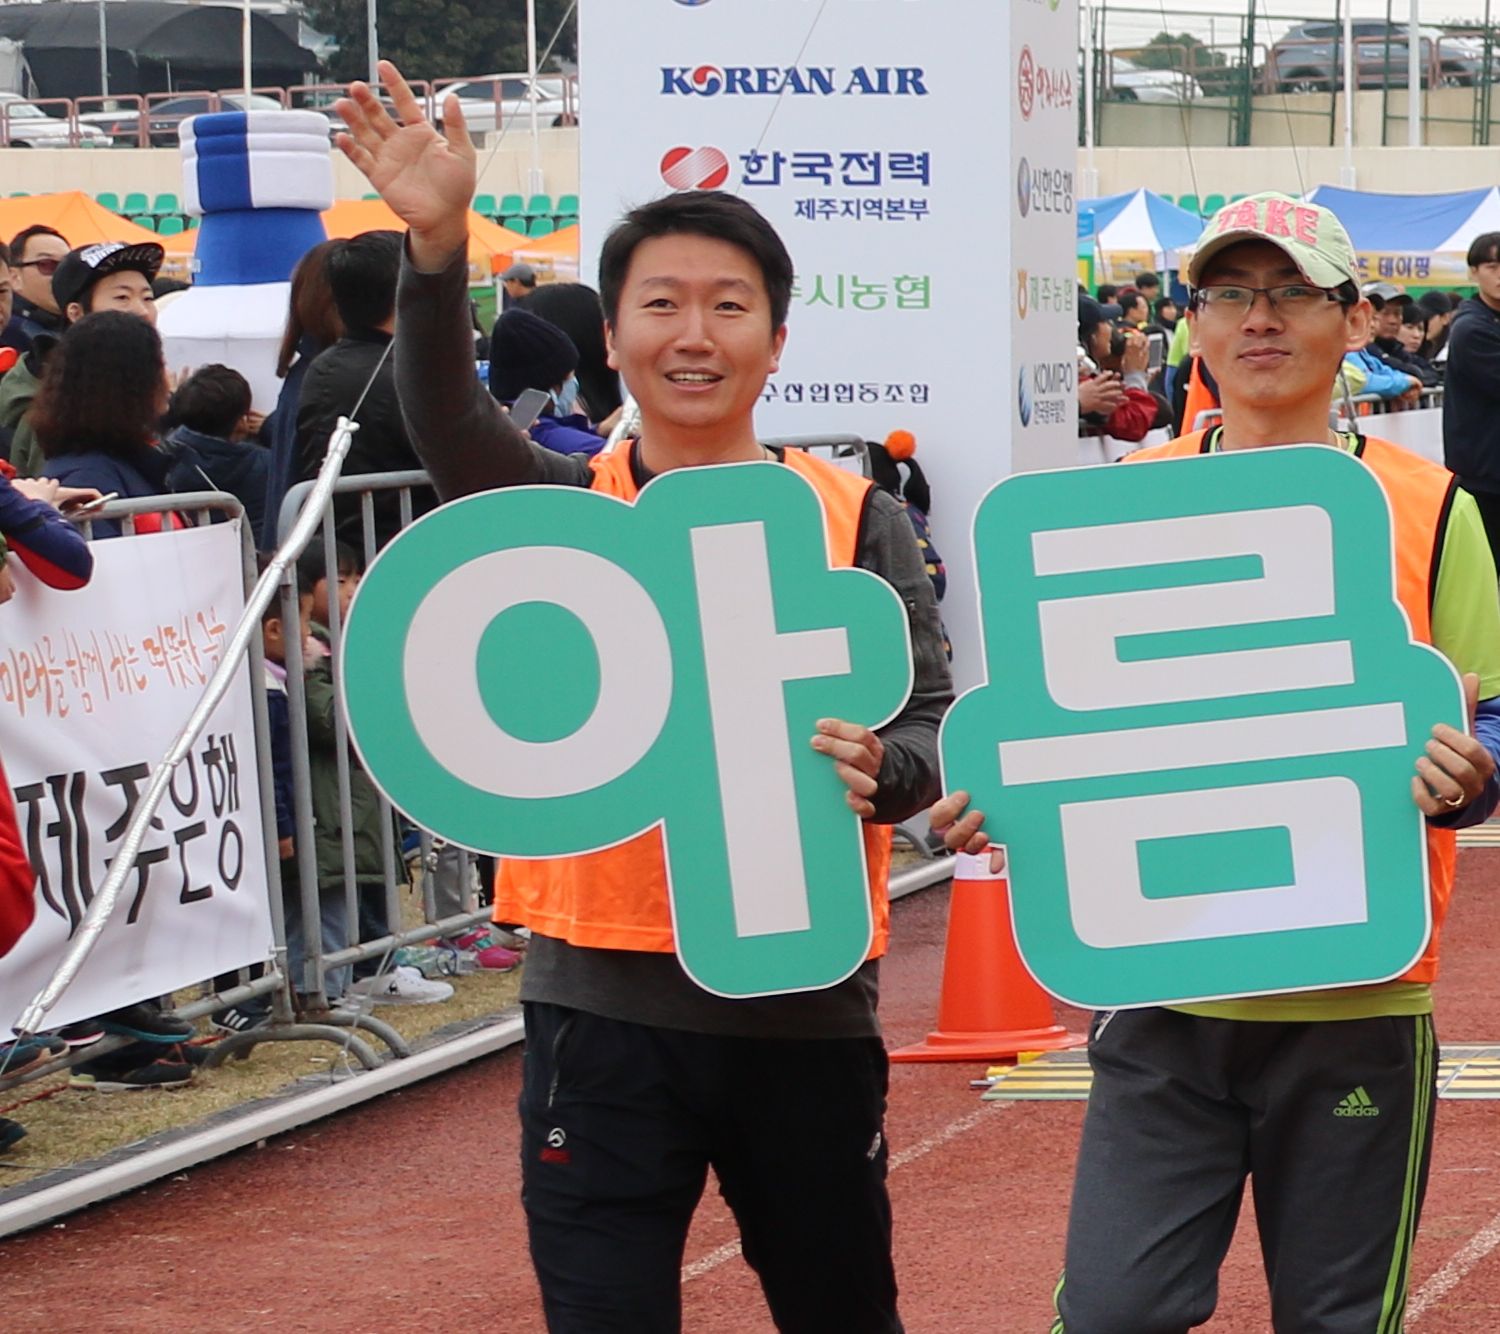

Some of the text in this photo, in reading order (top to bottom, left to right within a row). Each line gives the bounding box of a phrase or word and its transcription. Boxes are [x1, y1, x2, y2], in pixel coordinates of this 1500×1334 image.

[659, 64, 931, 98] KOREAN AIR
[738, 147, 932, 188] 한국전력
[793, 197, 931, 222] 제주지역본부
[1031, 173, 1073, 215] 신한은행
[1216, 198, 1320, 247] TAKE
[1378, 256, 1431, 279] 테이핑
[1029, 276, 1073, 314] 제주농협
[1033, 361, 1073, 395] KOMIPO
[403, 520, 851, 938] 아
[999, 504, 1408, 950] 름
[1332, 1104, 1380, 1117] adidas
